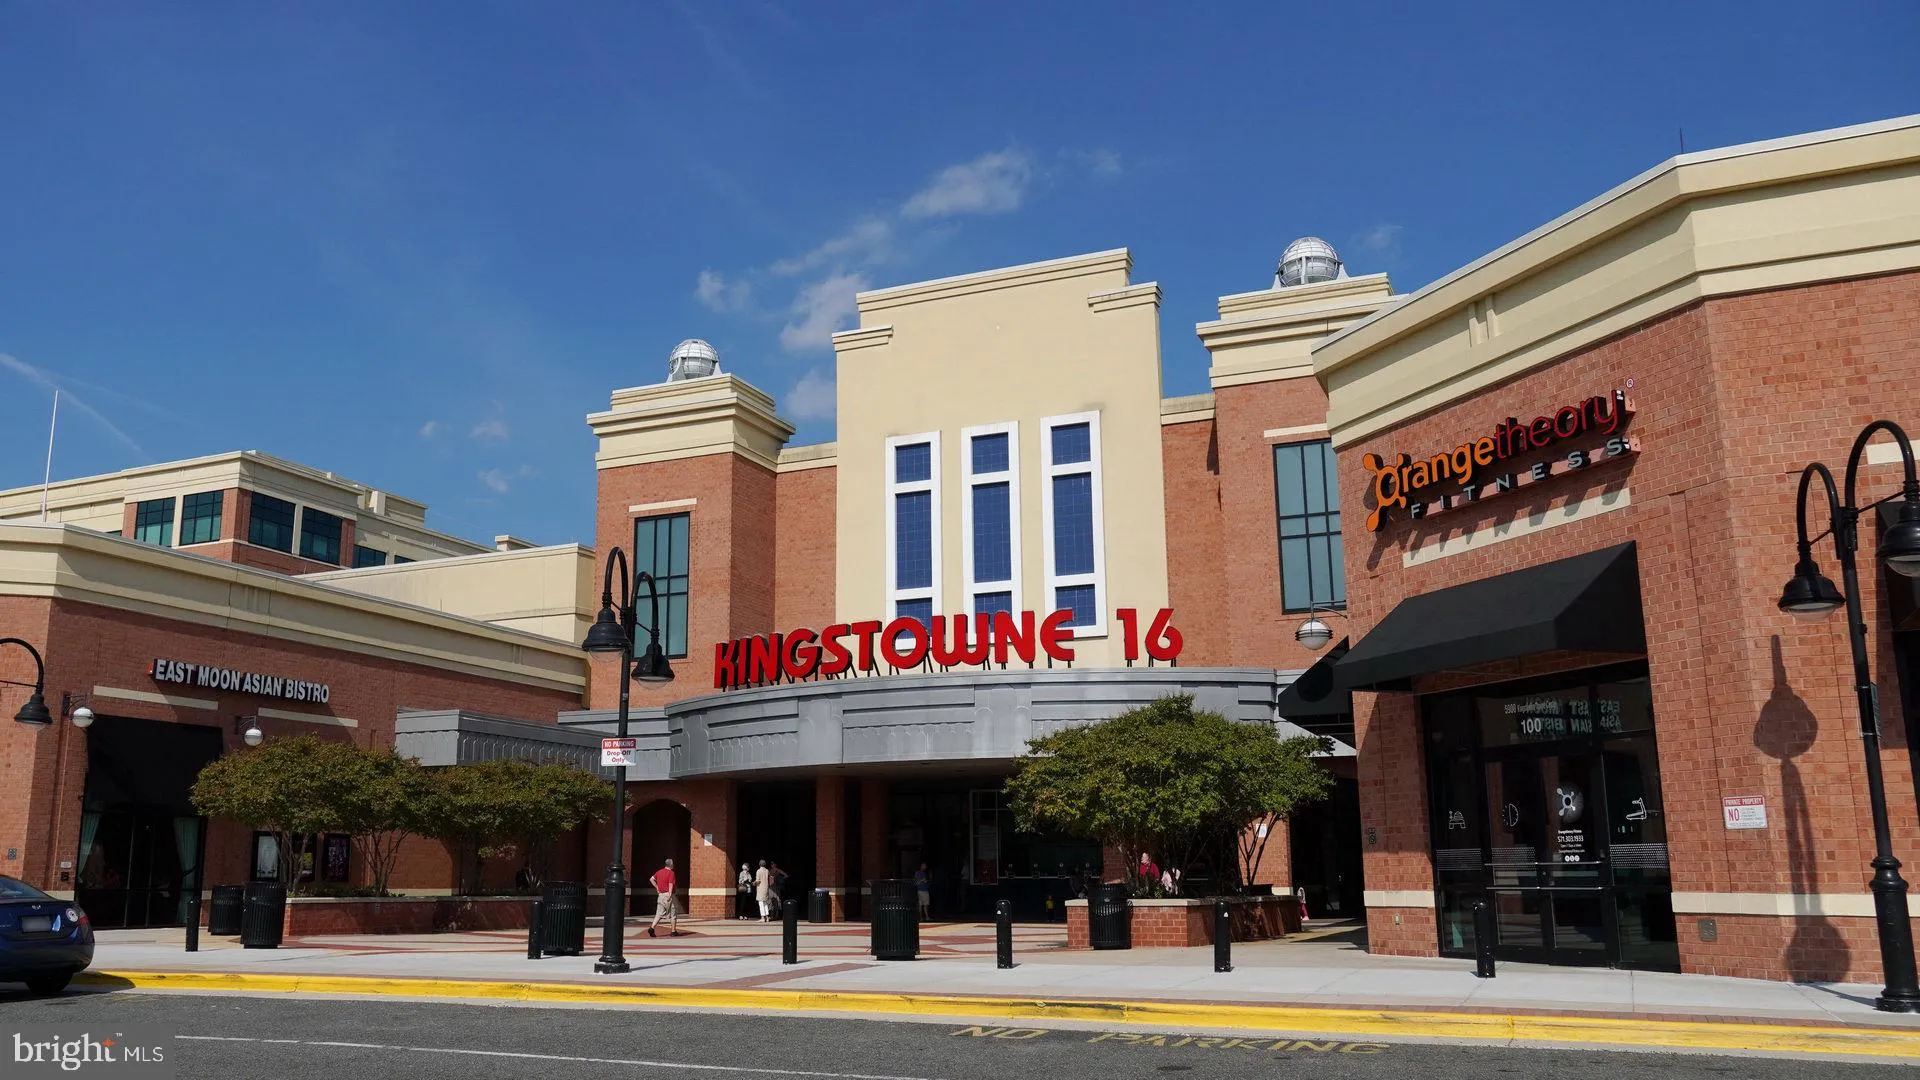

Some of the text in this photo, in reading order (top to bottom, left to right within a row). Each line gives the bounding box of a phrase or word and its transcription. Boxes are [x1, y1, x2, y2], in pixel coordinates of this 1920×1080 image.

[1410, 437, 1627, 518] FITNESS
[714, 608, 1184, 689] KINGSTOWNE 16
[155, 659, 330, 703] EAST MOON ASIAN BISTRO
[1520, 717, 1542, 734] 100
[1728, 808, 1740, 821] NO
[947, 1026, 1392, 1054] NO PARKING
